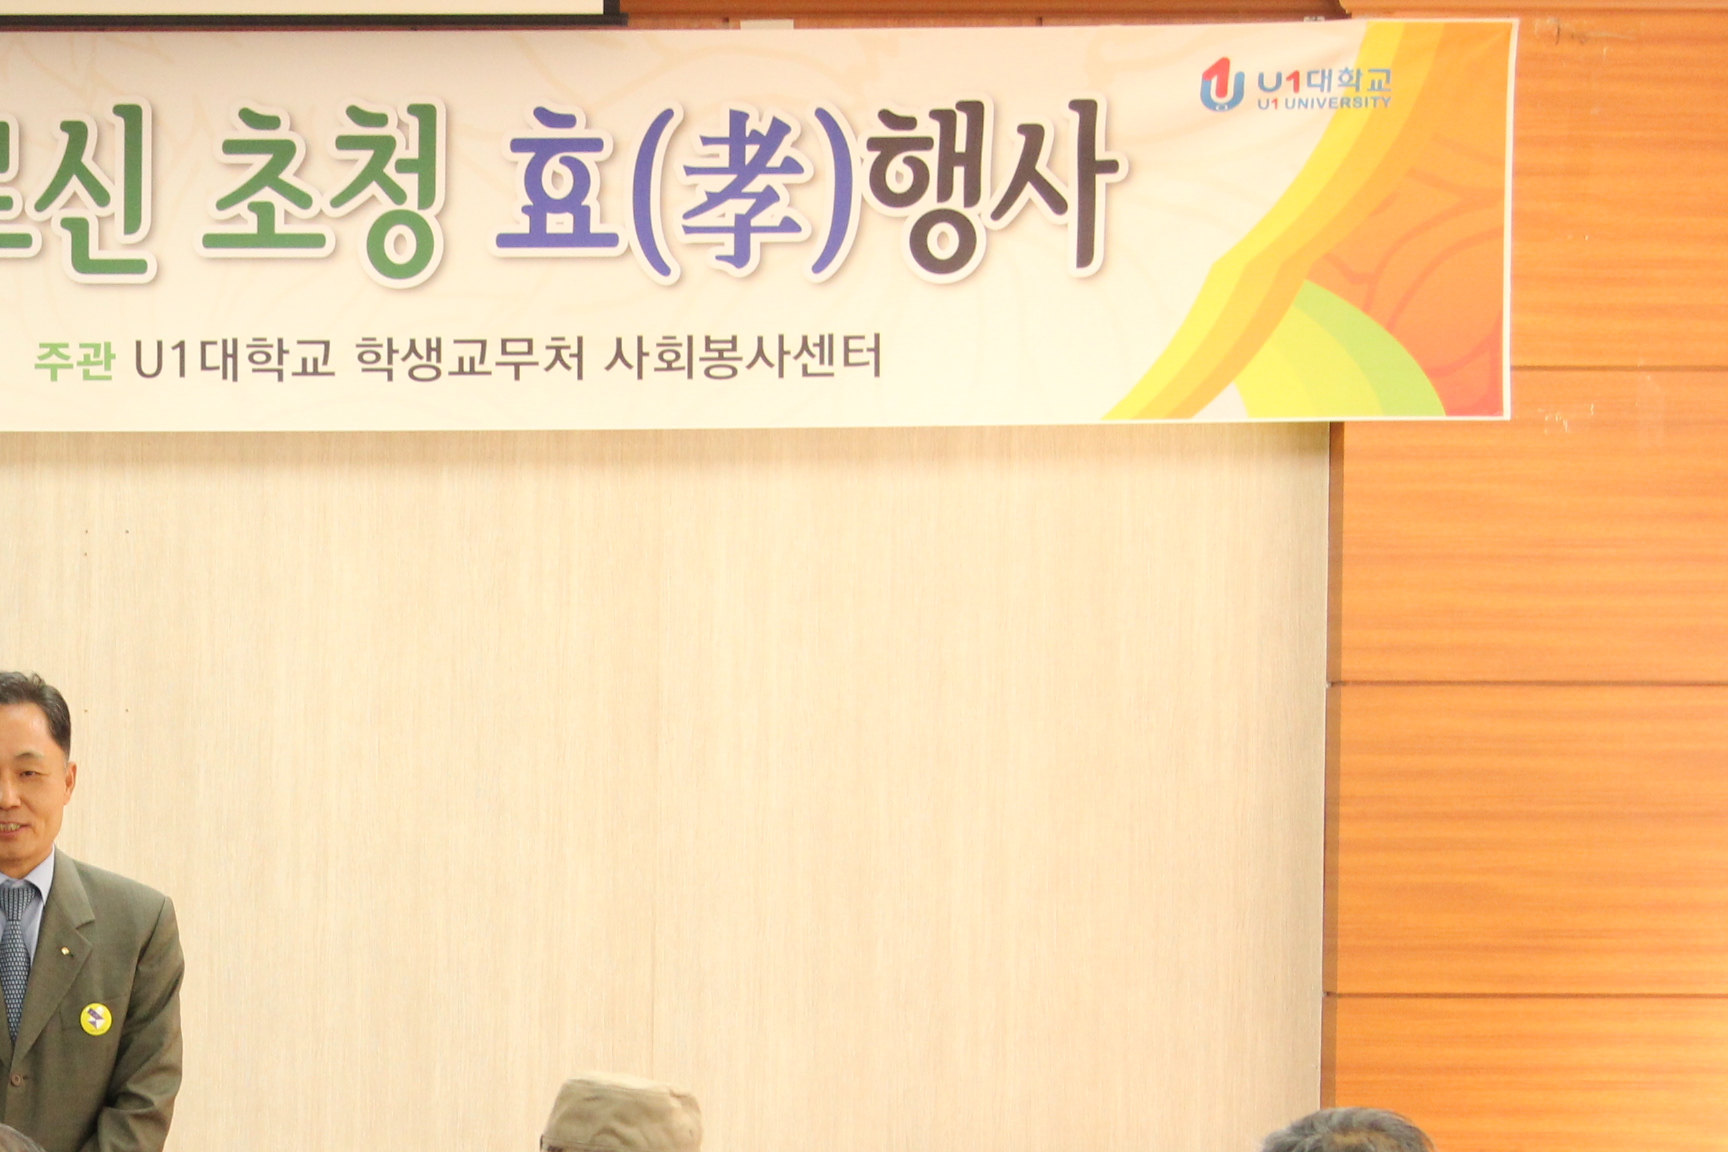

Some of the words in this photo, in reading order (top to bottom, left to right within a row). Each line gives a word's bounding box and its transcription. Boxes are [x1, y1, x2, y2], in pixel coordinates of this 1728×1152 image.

[1257, 67, 1392, 94] U1대학교
[1257, 98, 1279, 110] U1
[1284, 96, 1391, 110] UNIVERSITY
[201, 103, 437, 279] 초청
[495, 98, 1120, 277] 효(孝)행사
[34, 341, 116, 382] 주관
[135, 337, 336, 383] U1대학교
[355, 336, 584, 383] 학생교무처
[604, 333, 882, 381] 사회봉사센터
